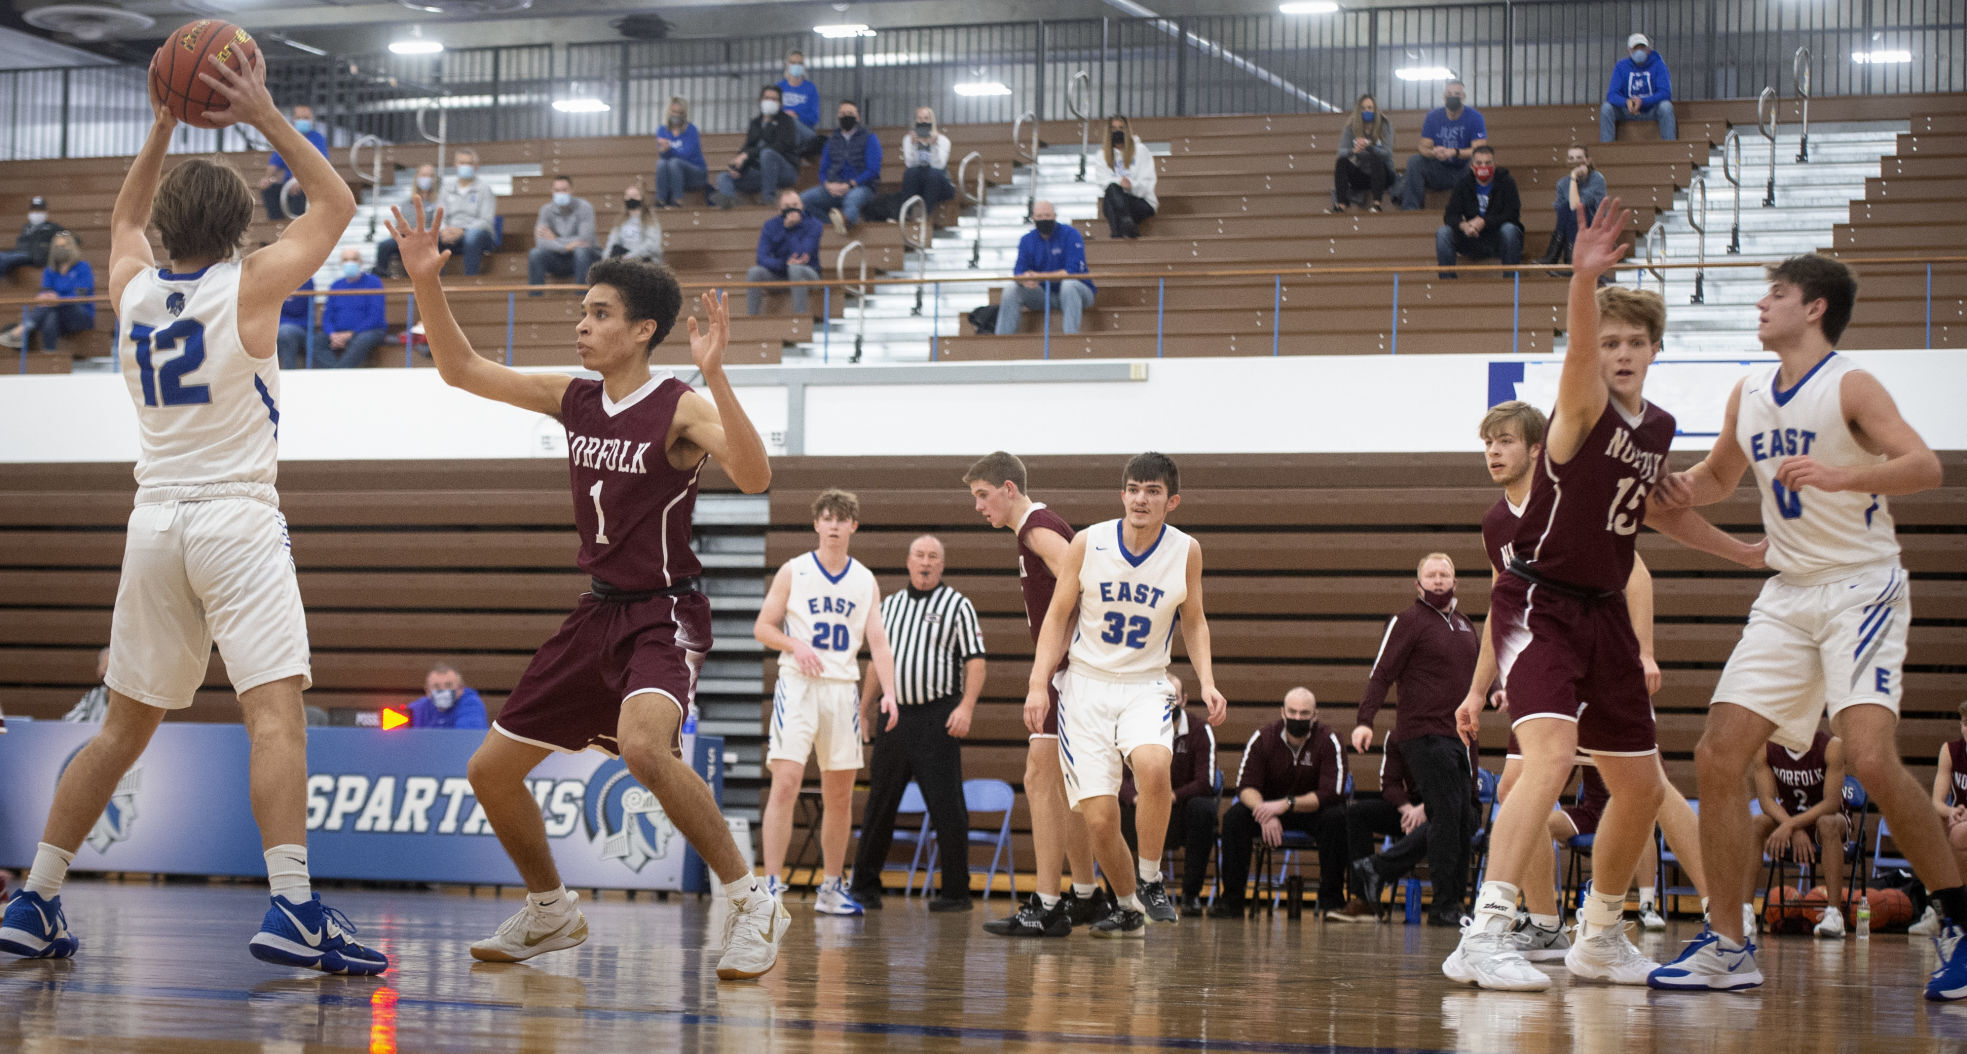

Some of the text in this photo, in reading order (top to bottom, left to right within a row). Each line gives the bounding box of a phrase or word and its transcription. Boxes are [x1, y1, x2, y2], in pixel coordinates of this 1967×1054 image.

[130, 317, 213, 408] 12
[1750, 427, 1816, 462] EAST
[589, 480, 609, 545] 1
[1605, 477, 1647, 535] 15
[808, 597, 856, 617] EAST
[1100, 582, 1165, 609] EAST
[812, 622, 849, 651] 20
[1101, 611, 1153, 649] 32
[1875, 666, 1891, 695] E
[1772, 766, 1825, 787] NORFOLK
